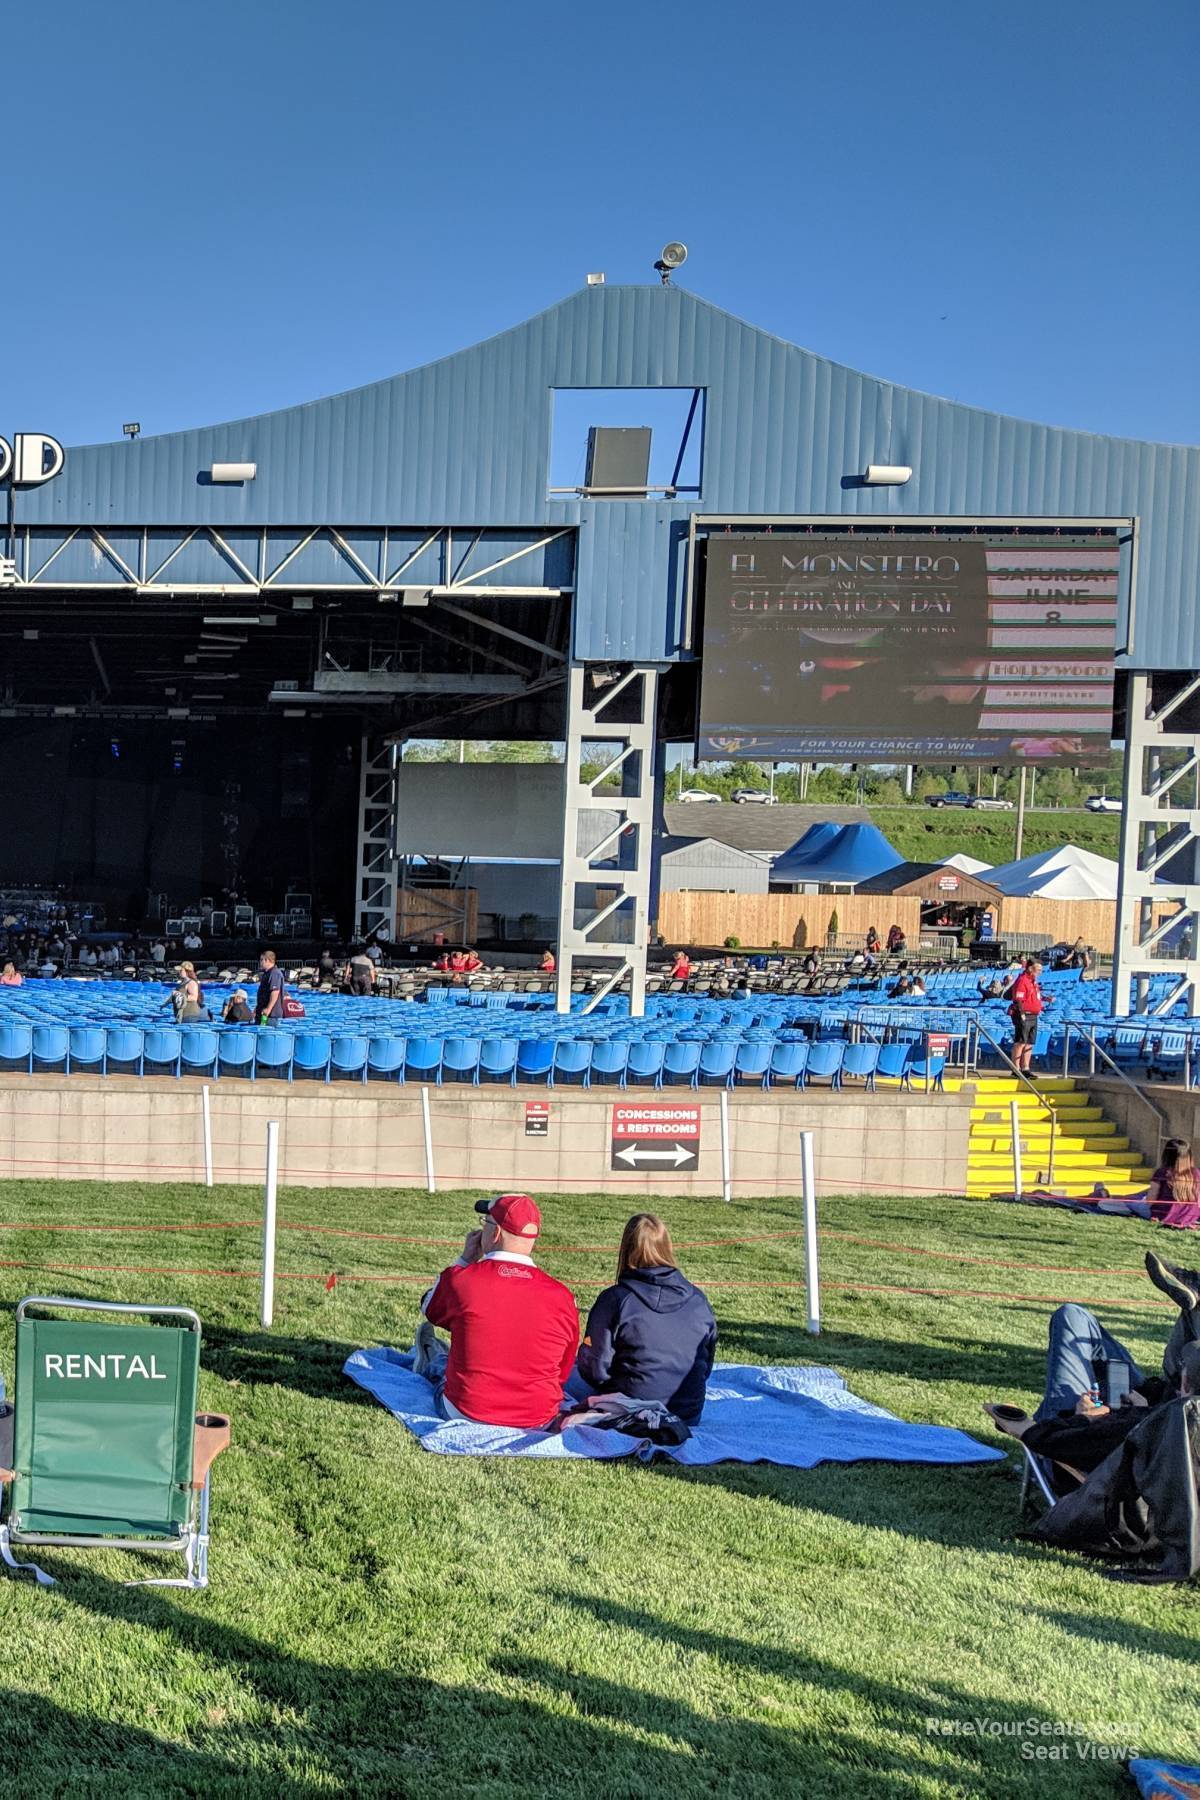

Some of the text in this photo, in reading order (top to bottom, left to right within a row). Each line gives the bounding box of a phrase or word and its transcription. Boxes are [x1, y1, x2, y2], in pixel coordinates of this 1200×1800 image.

[731, 553, 960, 580] EL MONSTERO
[996, 567, 1115, 582] SATURDAY
[731, 590, 952, 613] CELEBRATION DAY
[1019, 588, 1090, 605] JUNE
[993, 664, 1109, 676] HOLLYWOOD
[1005, 690, 1095, 699] AMPHITHEATRE
[800, 739, 975, 751] FOR YOUR CHANCE TO WIN
[617, 1109, 698, 1120] CONCESSIONS
[617, 1124, 697, 1133] & RESTROOMS
[45, 1354, 167, 1379] RENTAL
